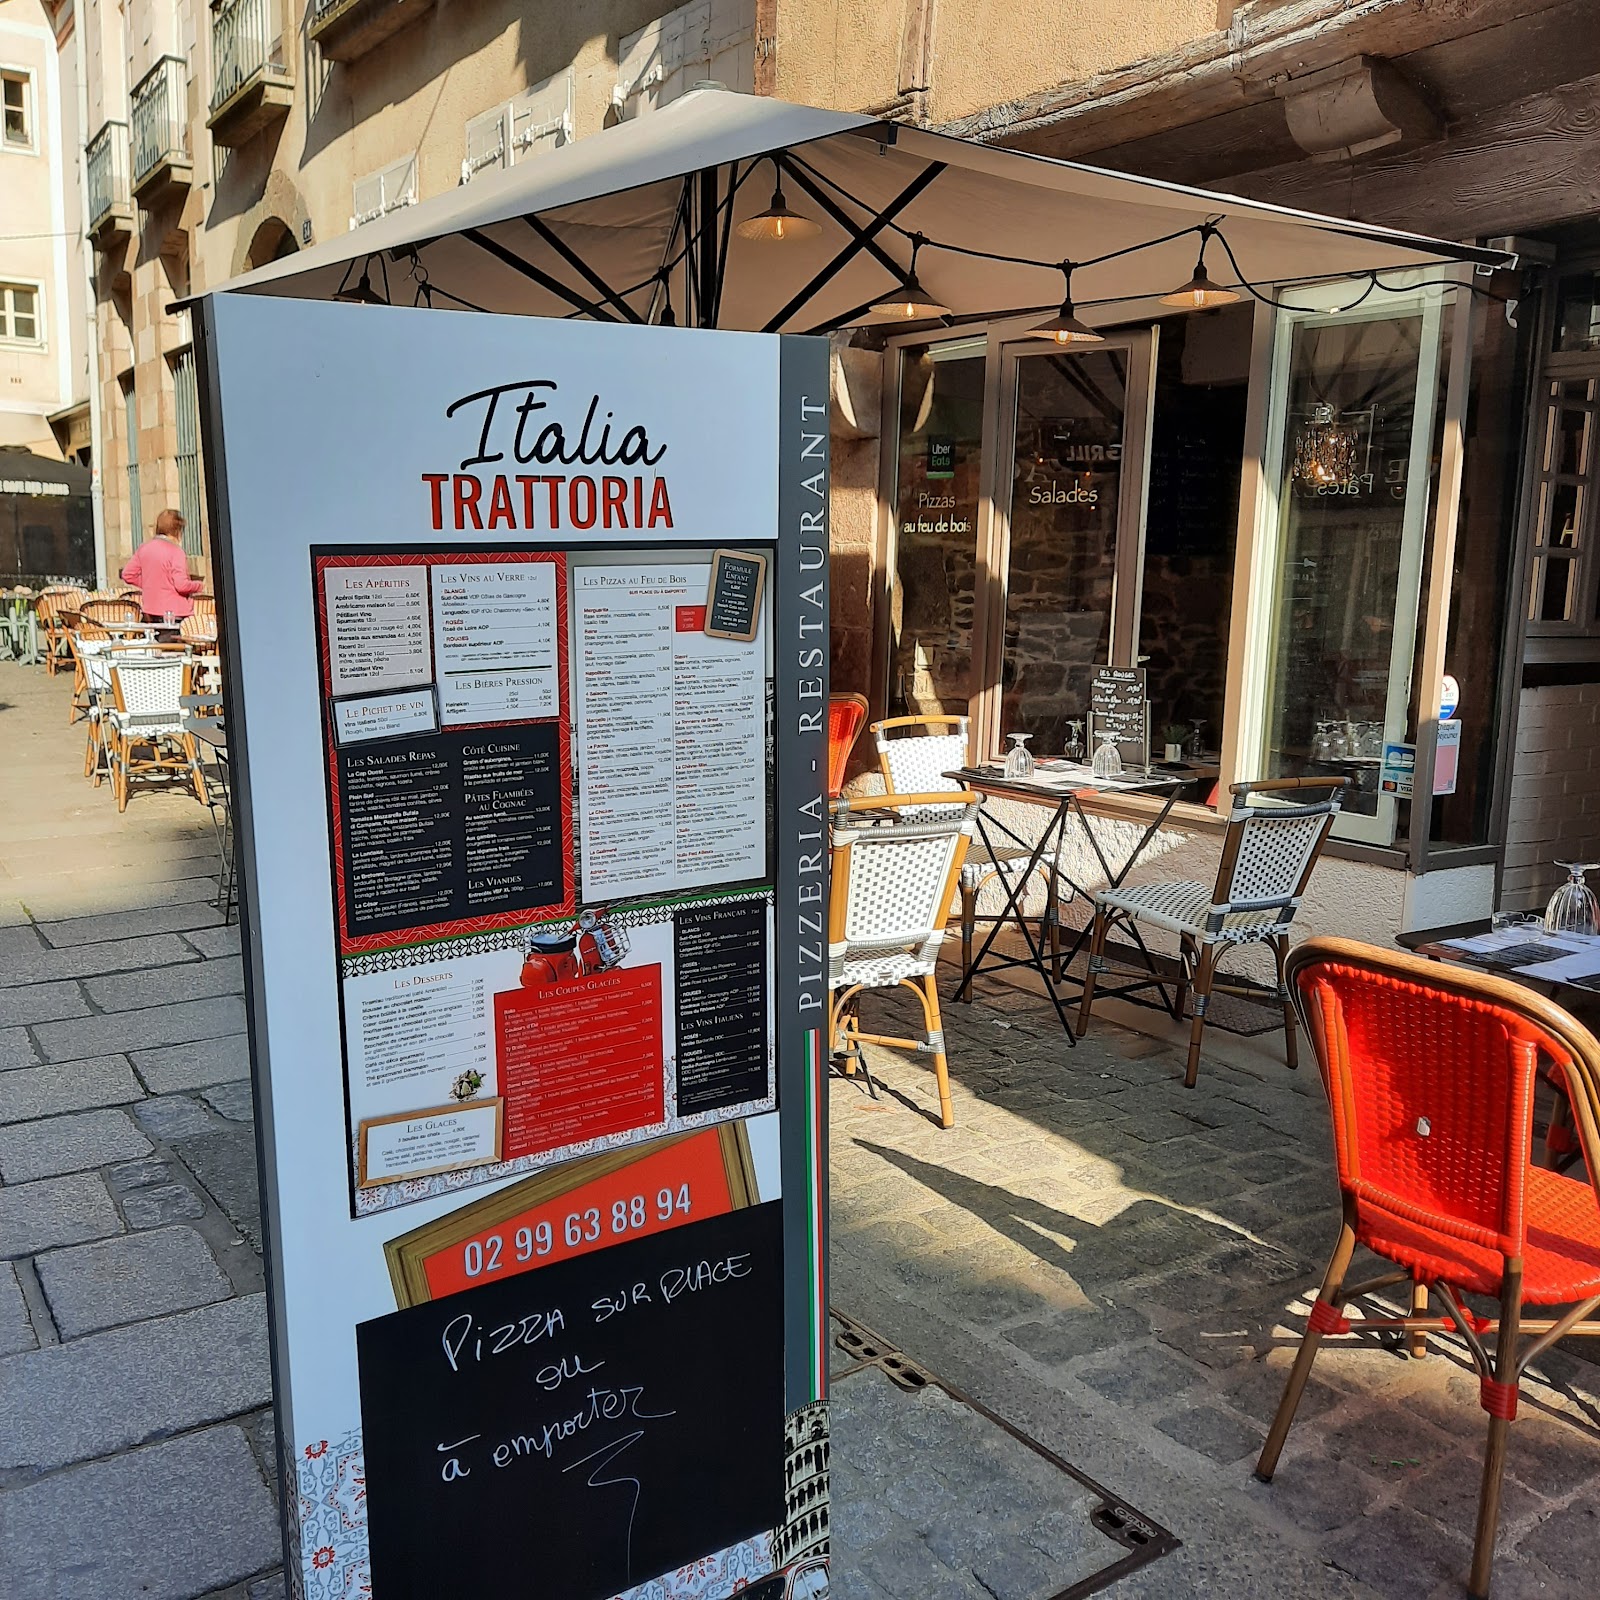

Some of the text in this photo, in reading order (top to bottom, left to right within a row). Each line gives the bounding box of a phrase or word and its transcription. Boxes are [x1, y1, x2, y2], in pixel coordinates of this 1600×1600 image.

[446, 380, 667, 471] Italia
[932, 444, 950, 454] Uber
[932, 456, 950, 466] Eats
[919, 491, 955, 509] Pizzas
[1029, 480, 1098, 504] Salades
[421, 473, 674, 530] TRATTORIA
[904, 514, 971, 533] au feu de bois
[724, 562, 752, 574] FORMULE
[798, 396, 827, 735] RESTAURANT
[345, 578, 410, 588] LES APÉRITIFS
[441, 574, 456, 583] LES
[460, 573, 480, 582] VINS
[497, 573, 525, 581] VERRE
[584, 577, 598, 585] LES
[600, 576, 626, 585] PIZZAS
[641, 576, 655, 584] FEU
[669, 575, 687, 583] BOIS
[726, 571, 749, 582] ENFANT
[455, 677, 543, 690] LES BIÈRES PRESSION
[346, 709, 360, 718] LE
[362, 705, 393, 717] PICHET
[410, 701, 424, 710] VIN
[463, 744, 520, 755] CÔTÉ CUISINE
[347, 752, 436, 767] LES SALADES REPAS
[465, 789, 534, 803] PÂTES FLAMBÉES
[479, 800, 526, 811] AU COGNAC
[469, 875, 521, 889] LES VIANDES
[798, 794, 823, 1013] PIZZERIA
[680, 909, 746, 925] LES VINS FRANÇAIS
[394, 972, 453, 989] LES DESSERTS
[539, 978, 620, 999] LES COUPES GLACÉES
[681, 1013, 743, 1030] LES VINS ITALIENS
[407, 1119, 457, 1133] LES GLACES
[464, 1183, 692, 1278] 02 99 63 88 94
[592, 1283, 652, 1322] SUR
[660, 1253, 752, 1303] PLACE
[536, 1355, 605, 1390] ou
[493, 1387, 676, 1468] emporter
